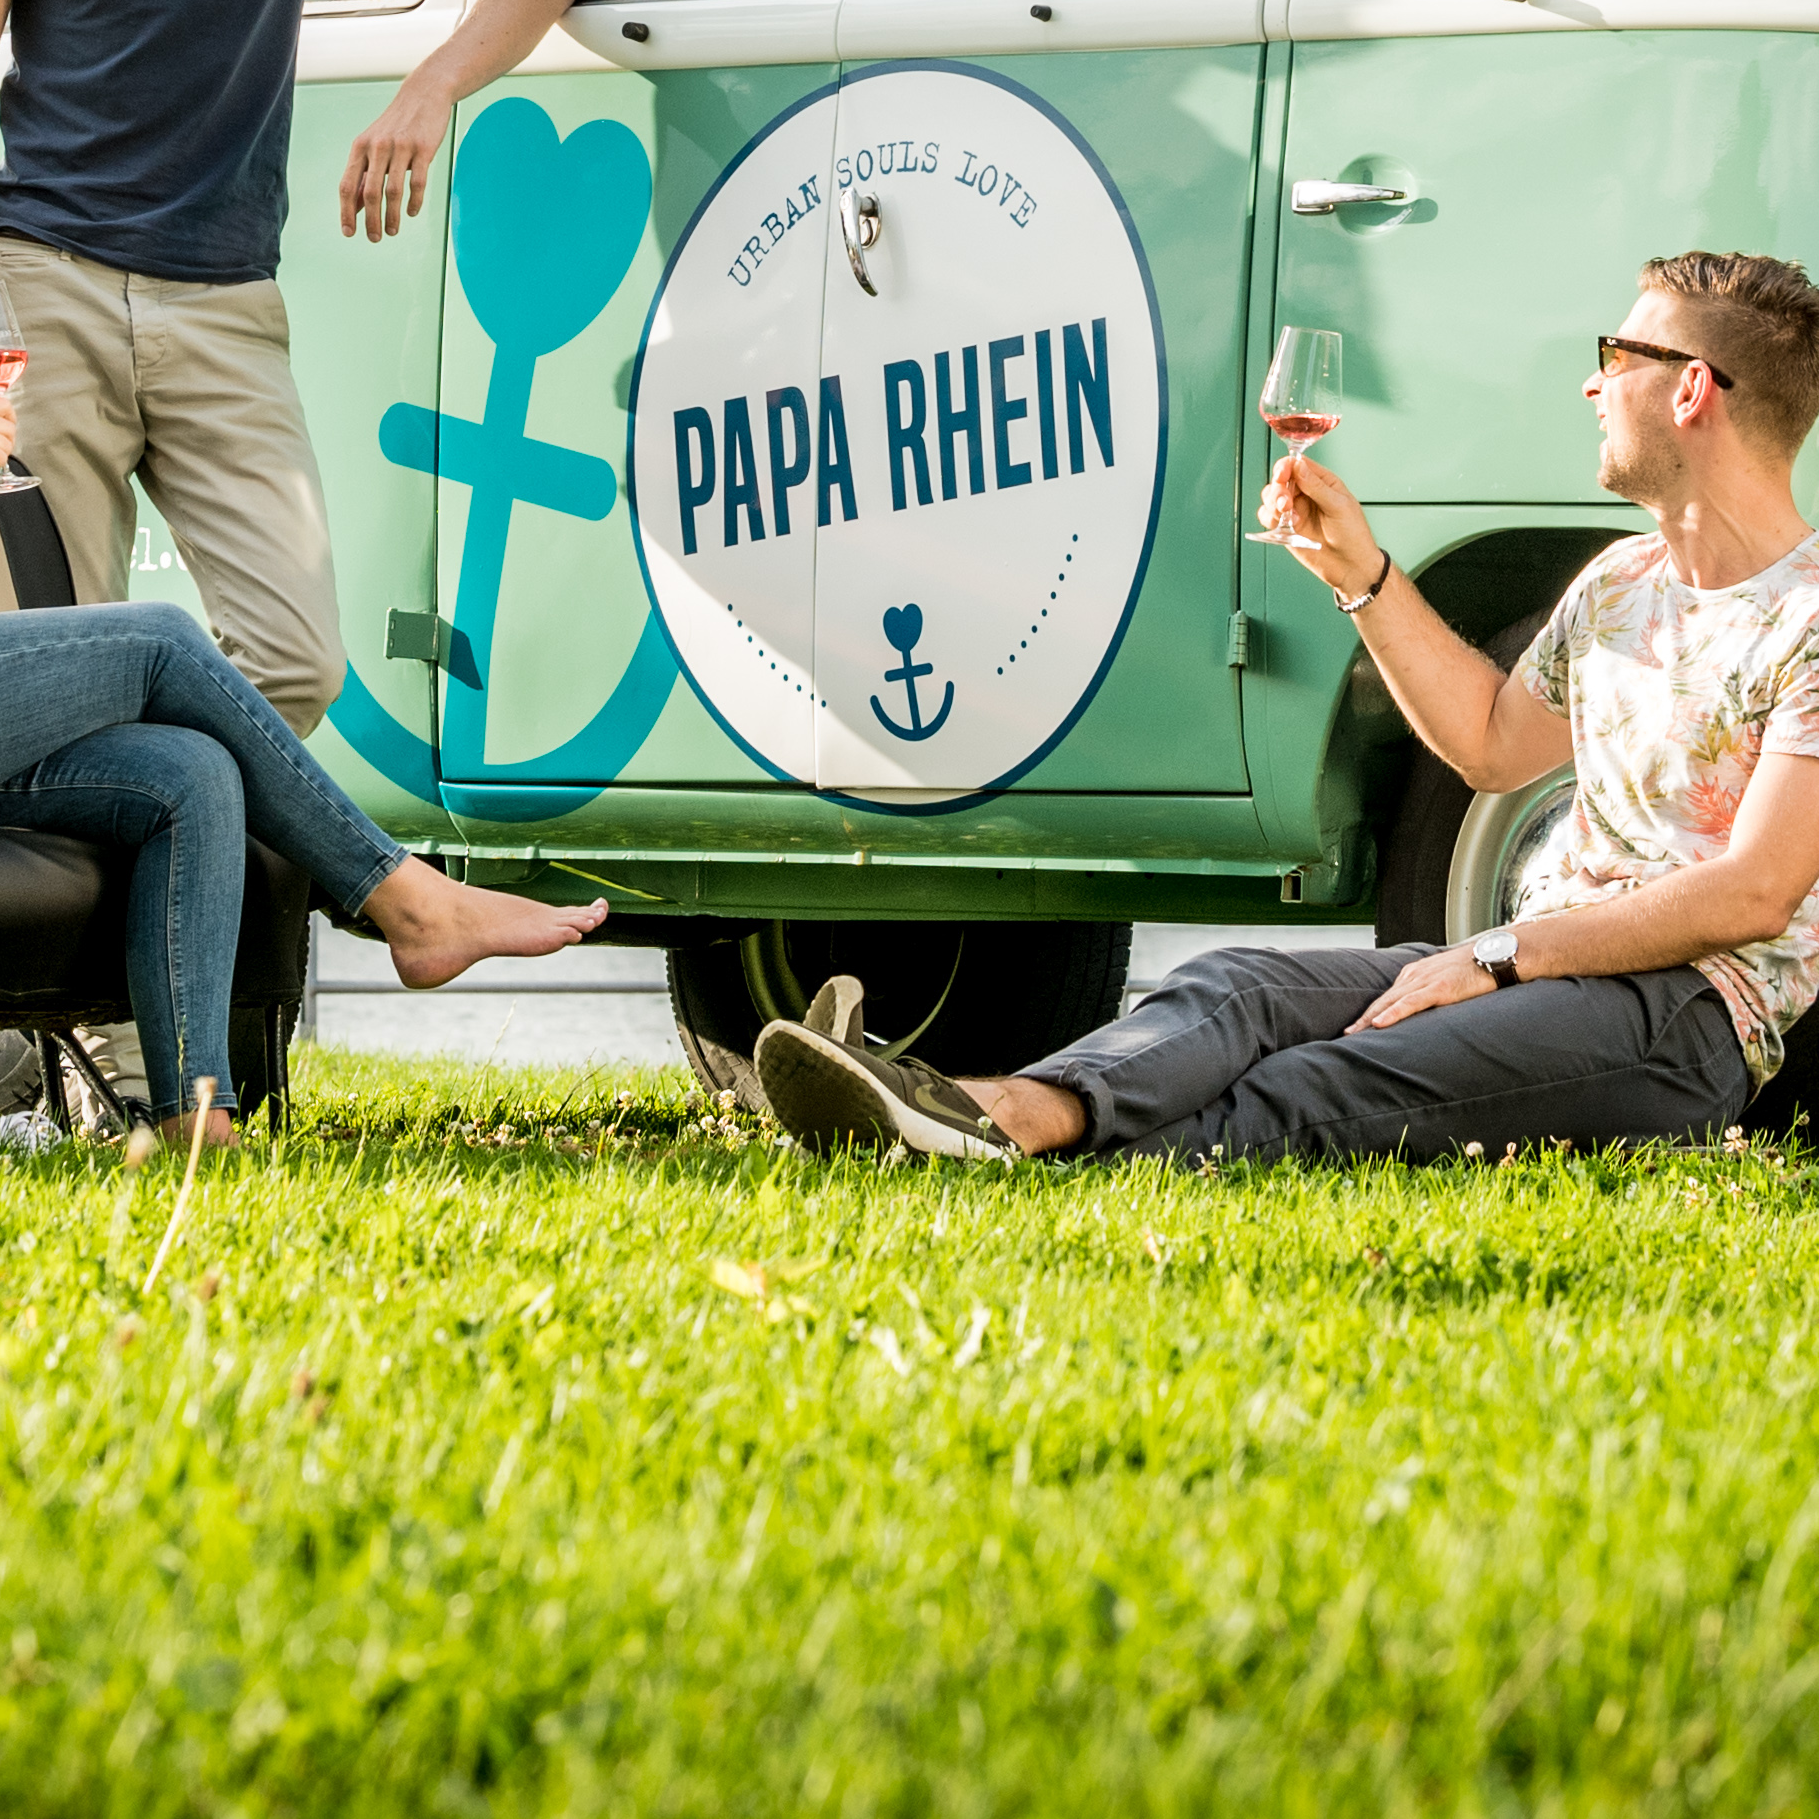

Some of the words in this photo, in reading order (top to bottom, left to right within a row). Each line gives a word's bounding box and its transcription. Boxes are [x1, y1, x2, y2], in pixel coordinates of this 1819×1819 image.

[727, 174, 822, 287] URBAN
[836, 140, 940, 189] SOULS
[955, 150, 1038, 229] LOVE
[673, 374, 859, 556] PAPA
[883, 317, 1115, 513] RHEIN
